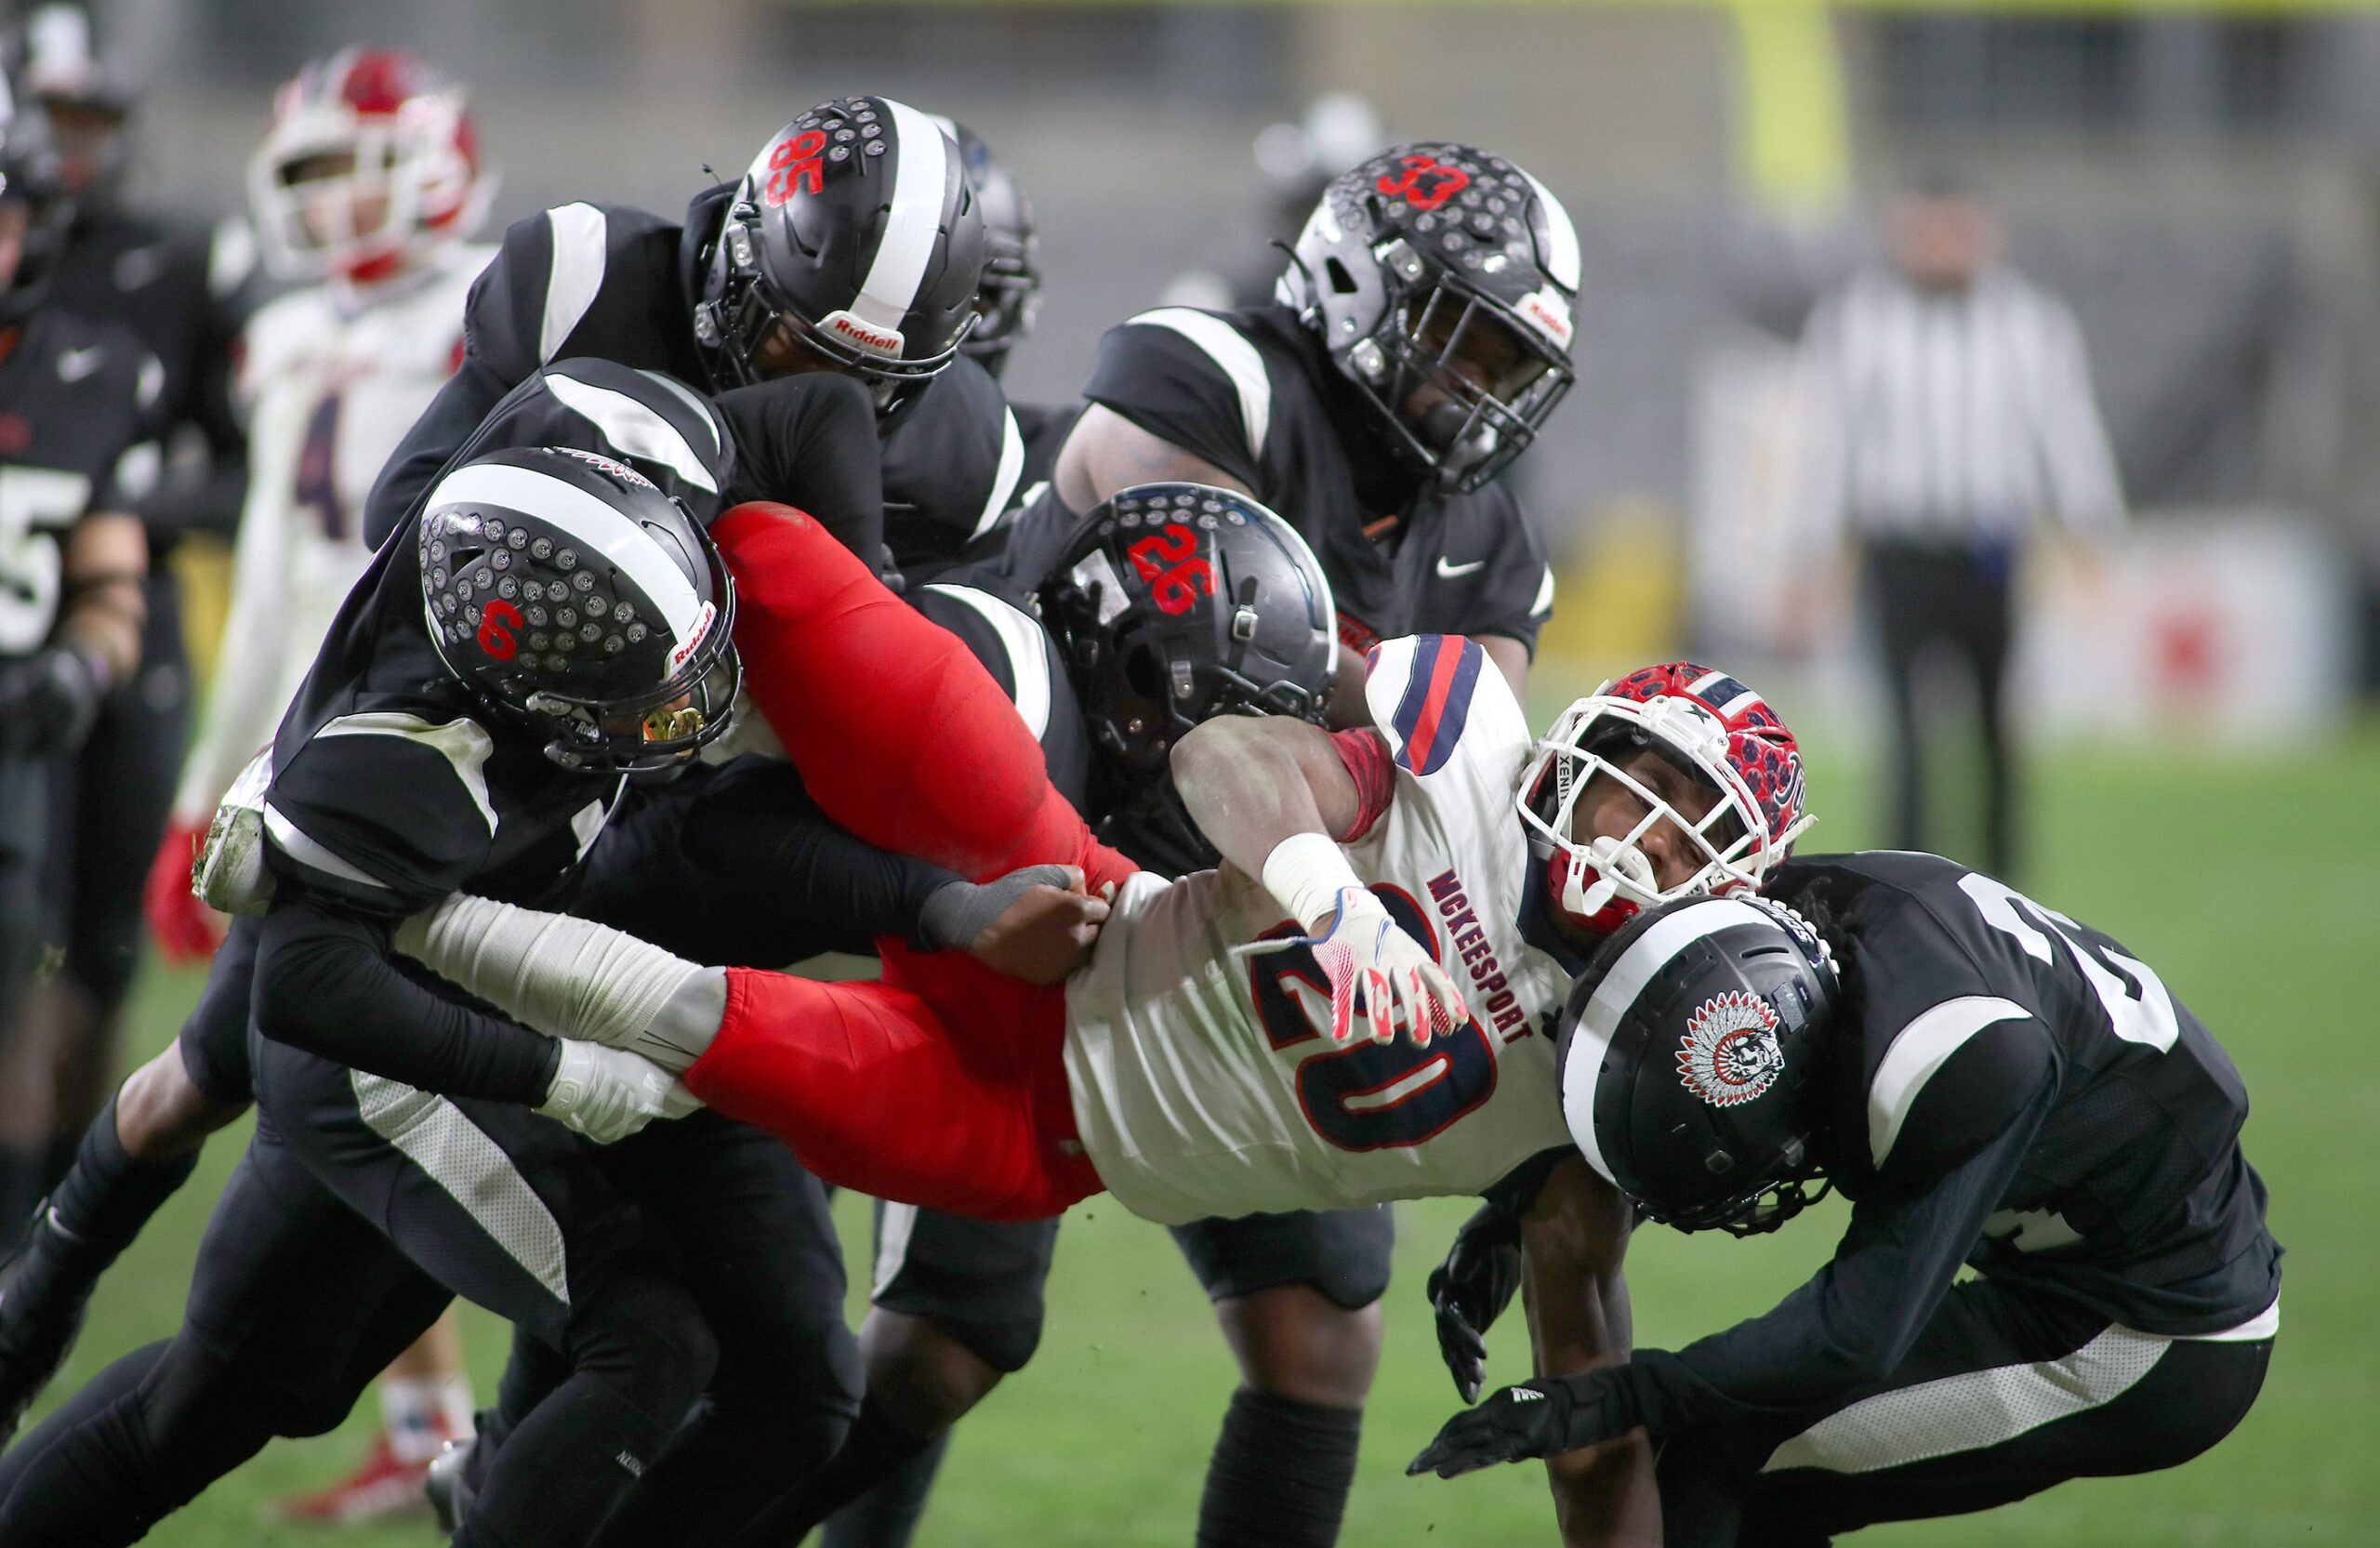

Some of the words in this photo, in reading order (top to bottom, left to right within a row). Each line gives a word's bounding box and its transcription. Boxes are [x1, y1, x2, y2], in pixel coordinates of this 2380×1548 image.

[764, 129, 826, 207] 85
[835, 318, 898, 351] Riddell
[1128, 523, 1219, 615] 26
[477, 598, 524, 661] 6
[674, 607, 714, 666] Riddell
[1559, 756, 1570, 807] XENIT
[1426, 868, 1534, 1045] MCKEESPORT
[1250, 882, 1498, 1152] 20
